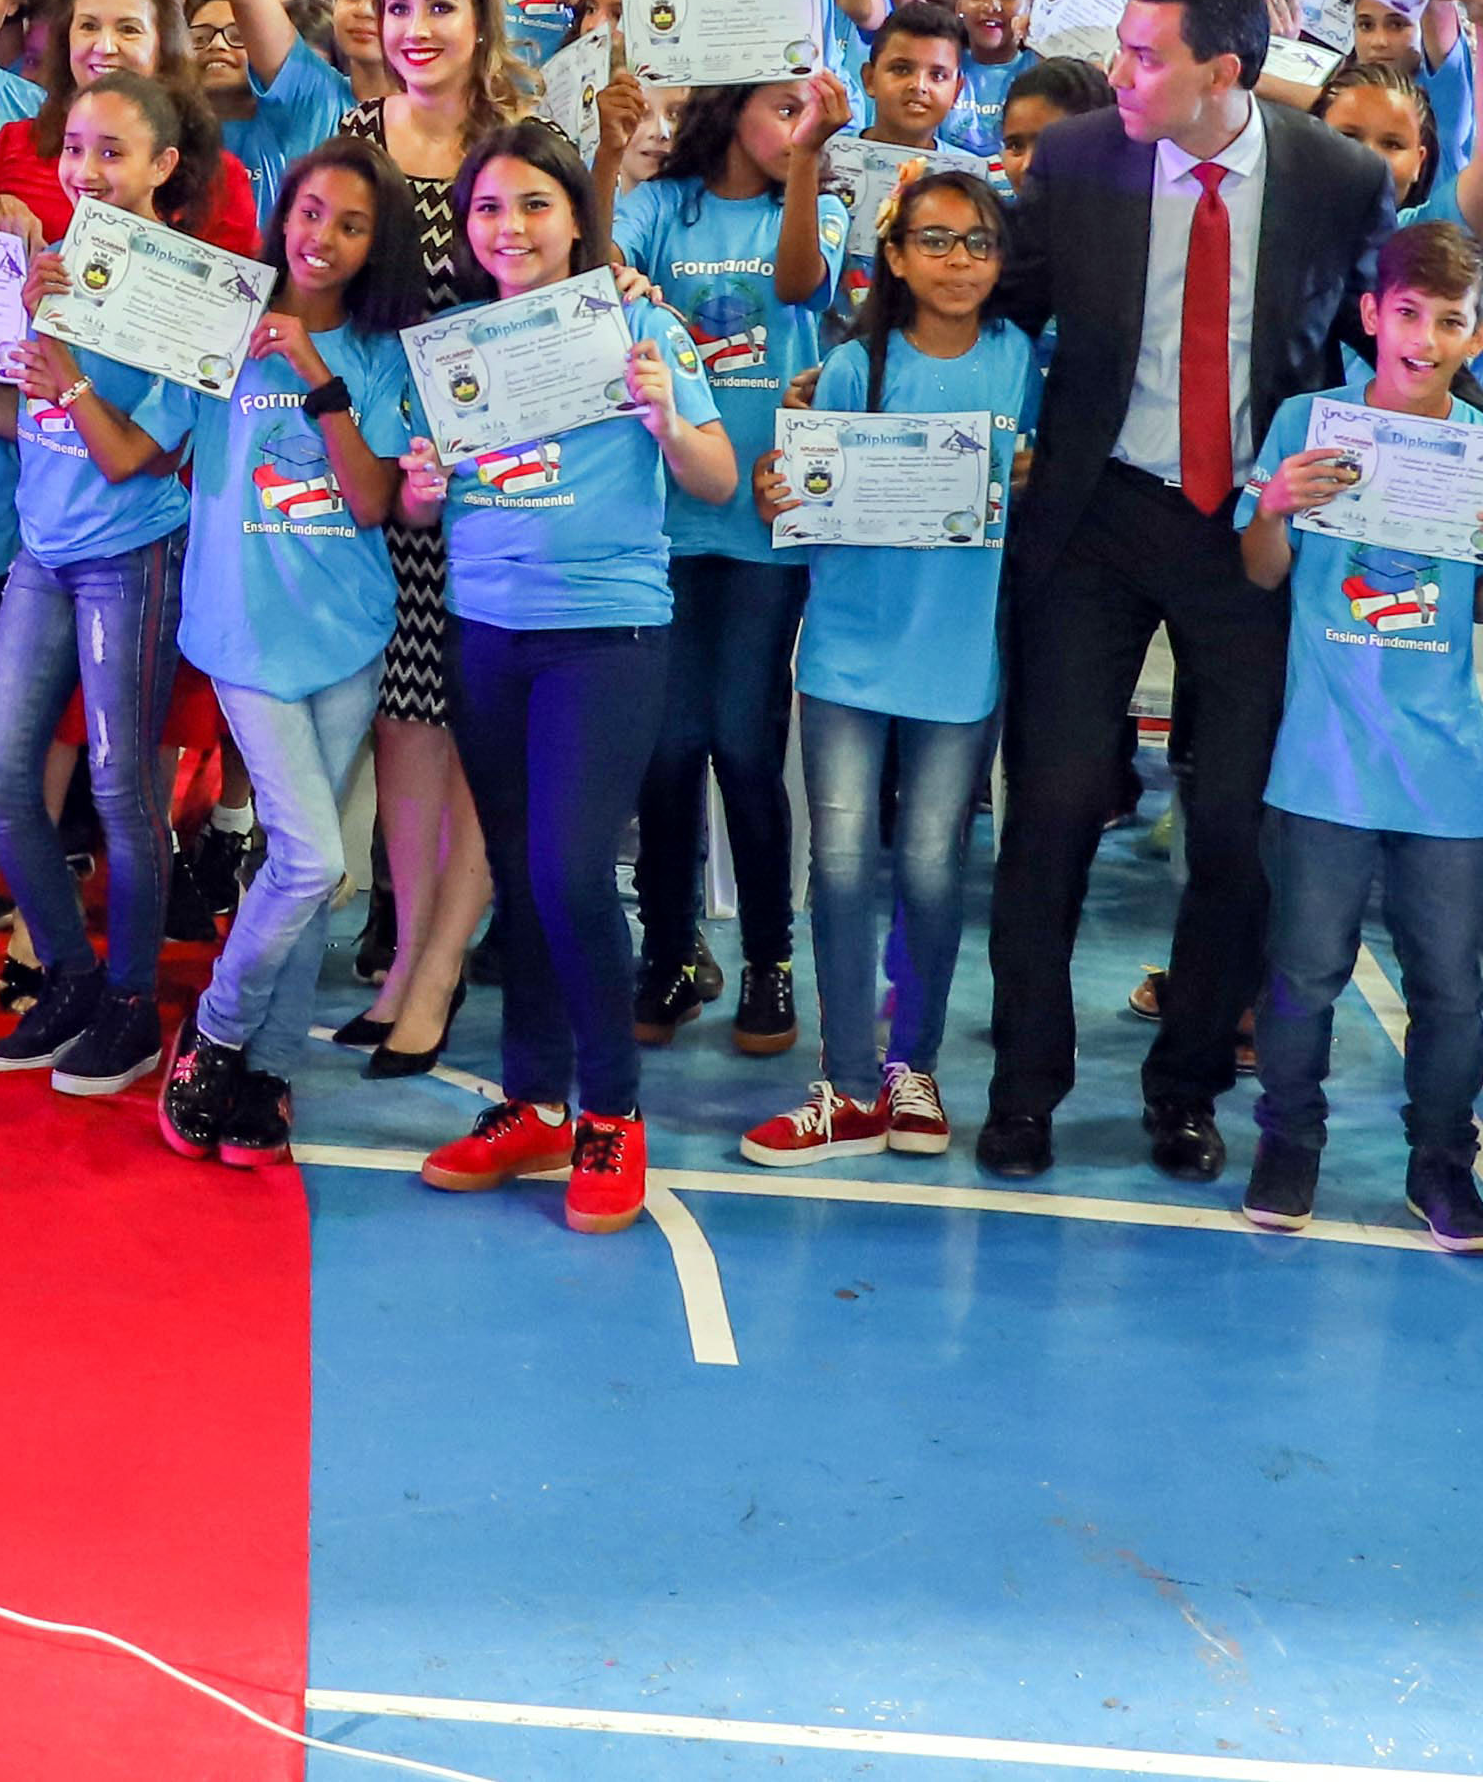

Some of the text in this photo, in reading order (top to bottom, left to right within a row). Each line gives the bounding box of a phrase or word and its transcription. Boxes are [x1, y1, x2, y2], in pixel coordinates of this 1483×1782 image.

[671, 257, 775, 279] Formando
[495, 493, 575, 508] Fundamental
[243, 520, 356, 538] Ensino Fundamental
[1326, 628, 1450, 653] Ensino Fundamental
